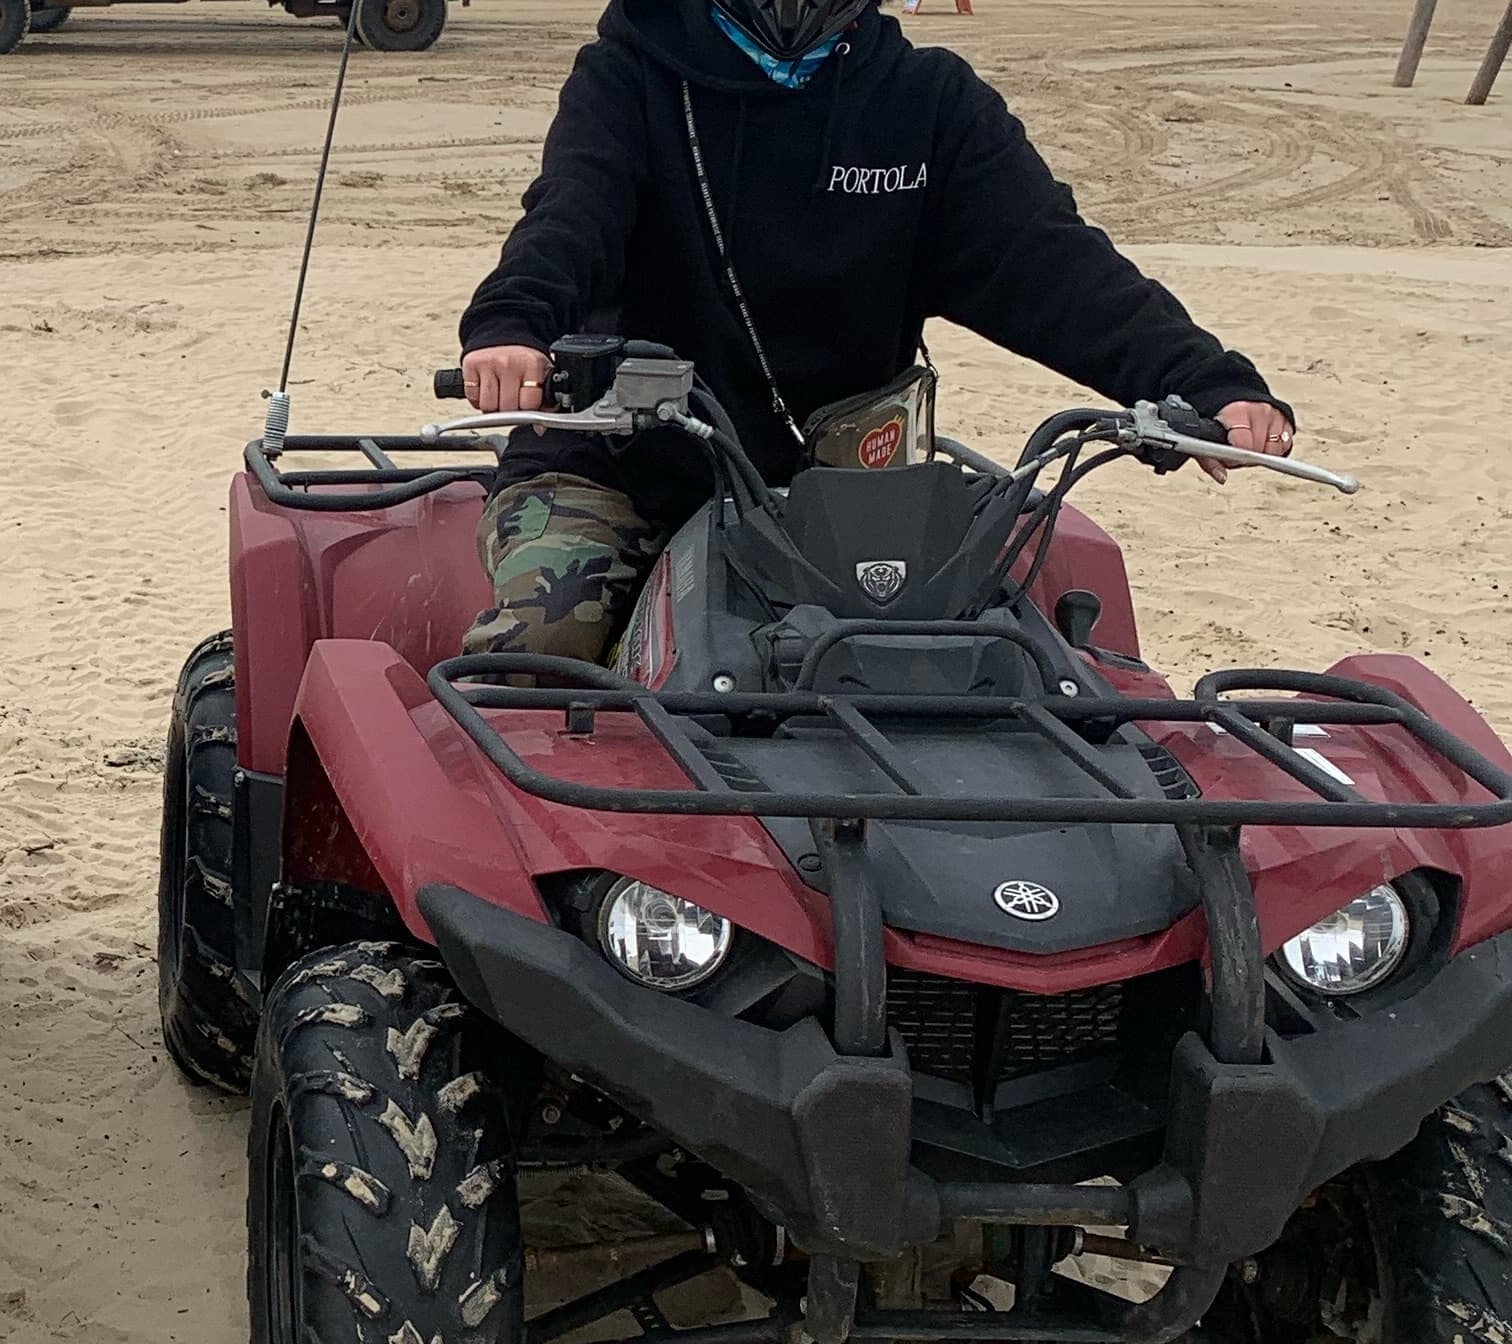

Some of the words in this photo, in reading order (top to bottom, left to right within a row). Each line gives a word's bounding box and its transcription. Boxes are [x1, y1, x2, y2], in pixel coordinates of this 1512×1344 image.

[827, 162, 927, 194] PORTOLA
[865, 429, 896, 452] HUMAN
[868, 444, 891, 464] MADE
